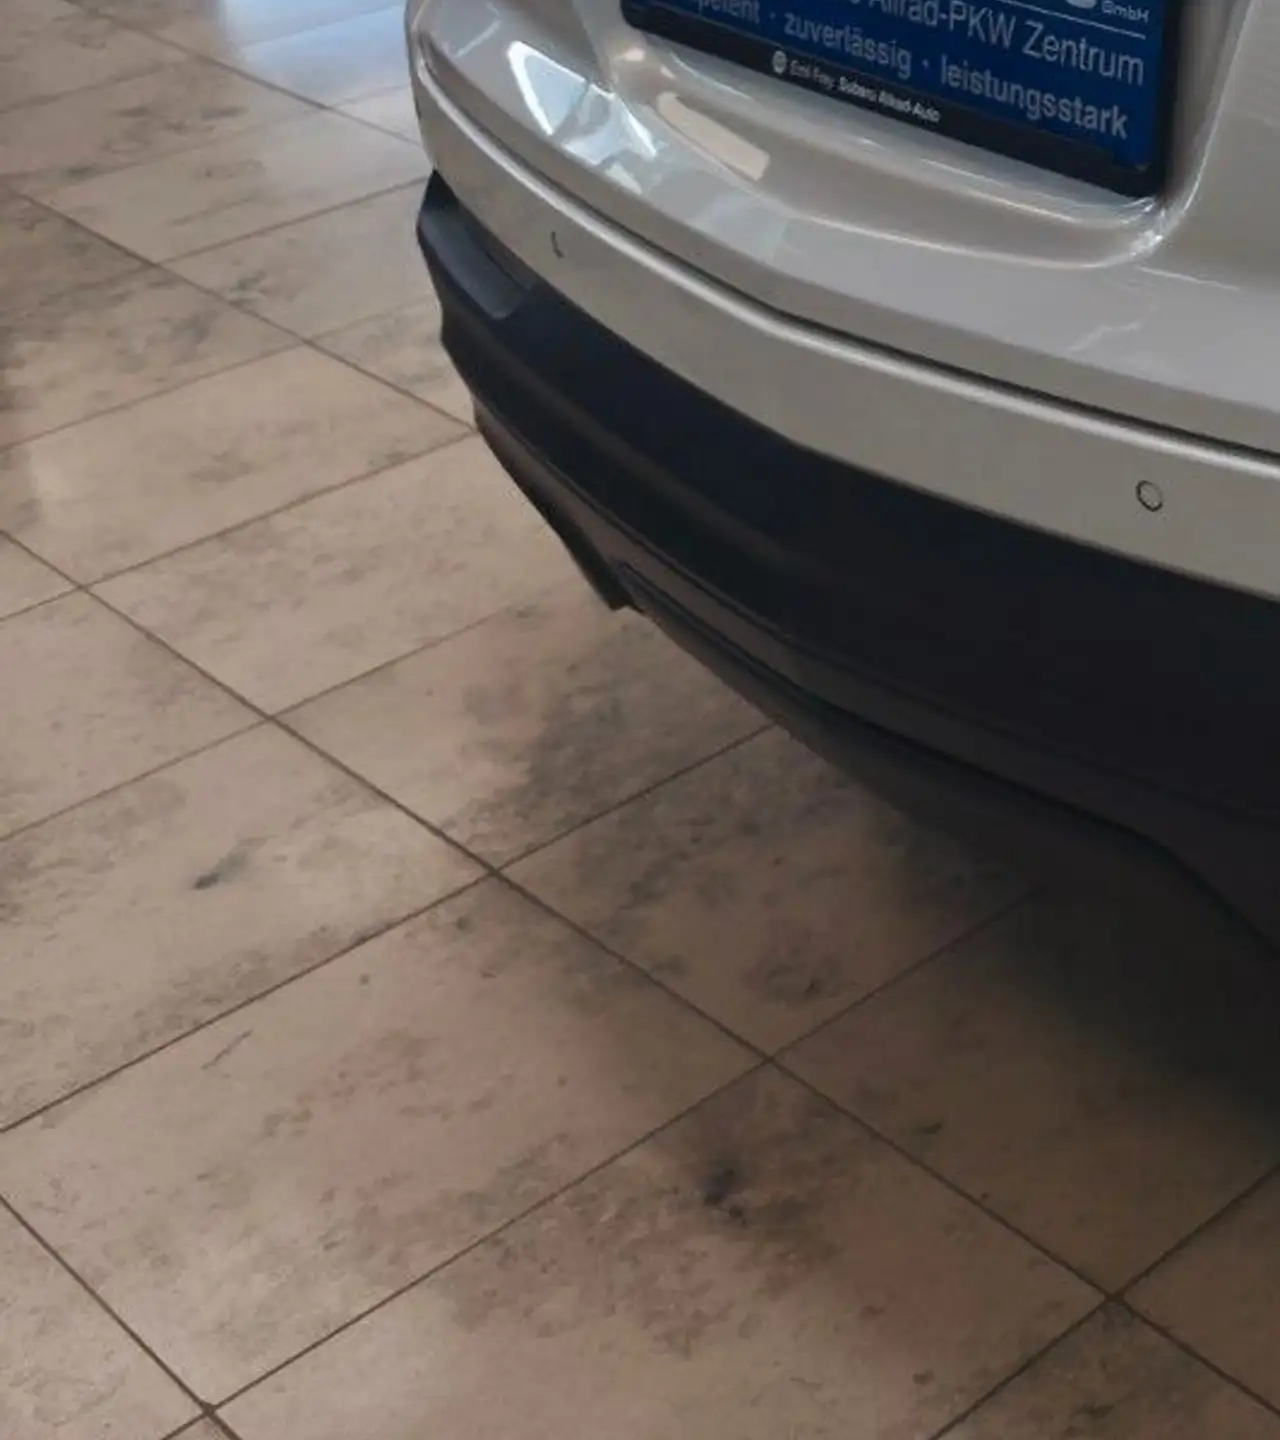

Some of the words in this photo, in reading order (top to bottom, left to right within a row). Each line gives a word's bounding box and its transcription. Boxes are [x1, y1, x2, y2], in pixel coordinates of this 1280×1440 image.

[784, 12, 912, 80] zuverlässig
[941, 54, 1128, 140] leistungsstark
[1022, 20, 1144, 86] Zentrum
